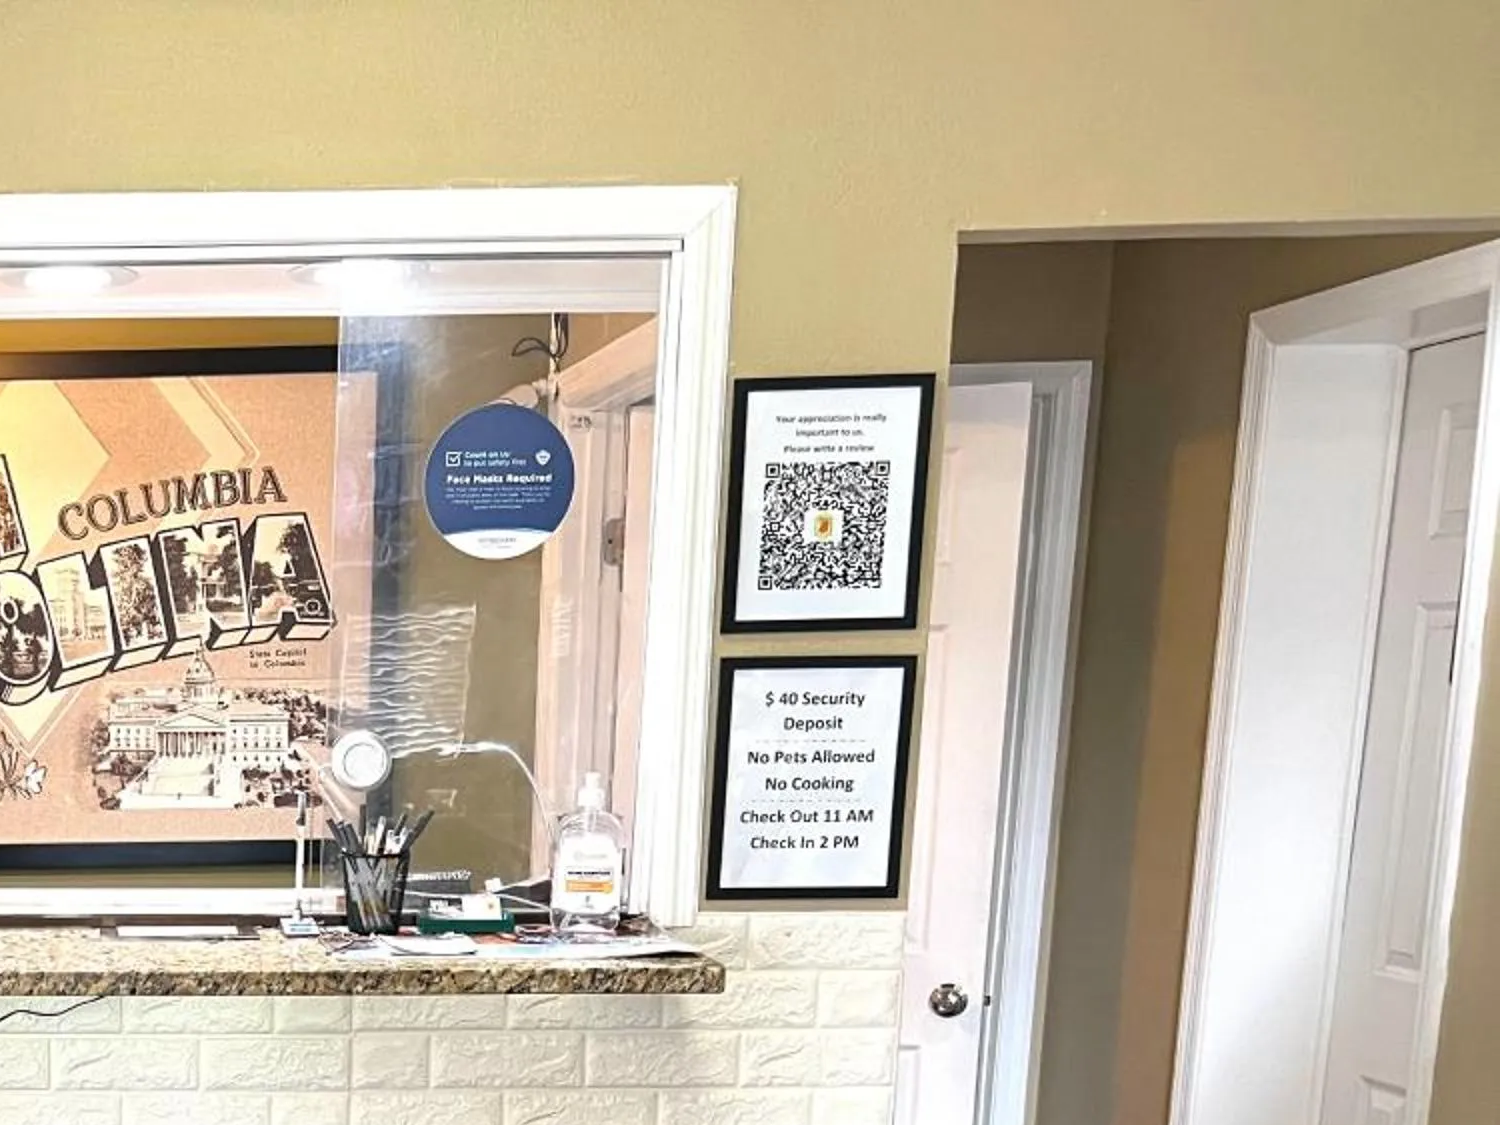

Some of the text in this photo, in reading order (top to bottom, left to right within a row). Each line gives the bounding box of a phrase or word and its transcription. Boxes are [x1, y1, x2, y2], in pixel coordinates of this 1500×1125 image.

[776, 415, 796, 423] Your
[795, 428, 838, 438] important
[783, 445, 811, 453] Please
[446, 472, 553, 484] Face Masks Required
[58, 465, 288, 542] COLUMBIA
[765, 691, 866, 708] $ 40 Security
[784, 716, 844, 732] Deposit
[747, 749, 876, 764] No Pets Allowed
[765, 776, 855, 793] No Cooking
[740, 809, 875, 823] Check Out 11 AM
[750, 835, 860, 849] Check In 2 PM
